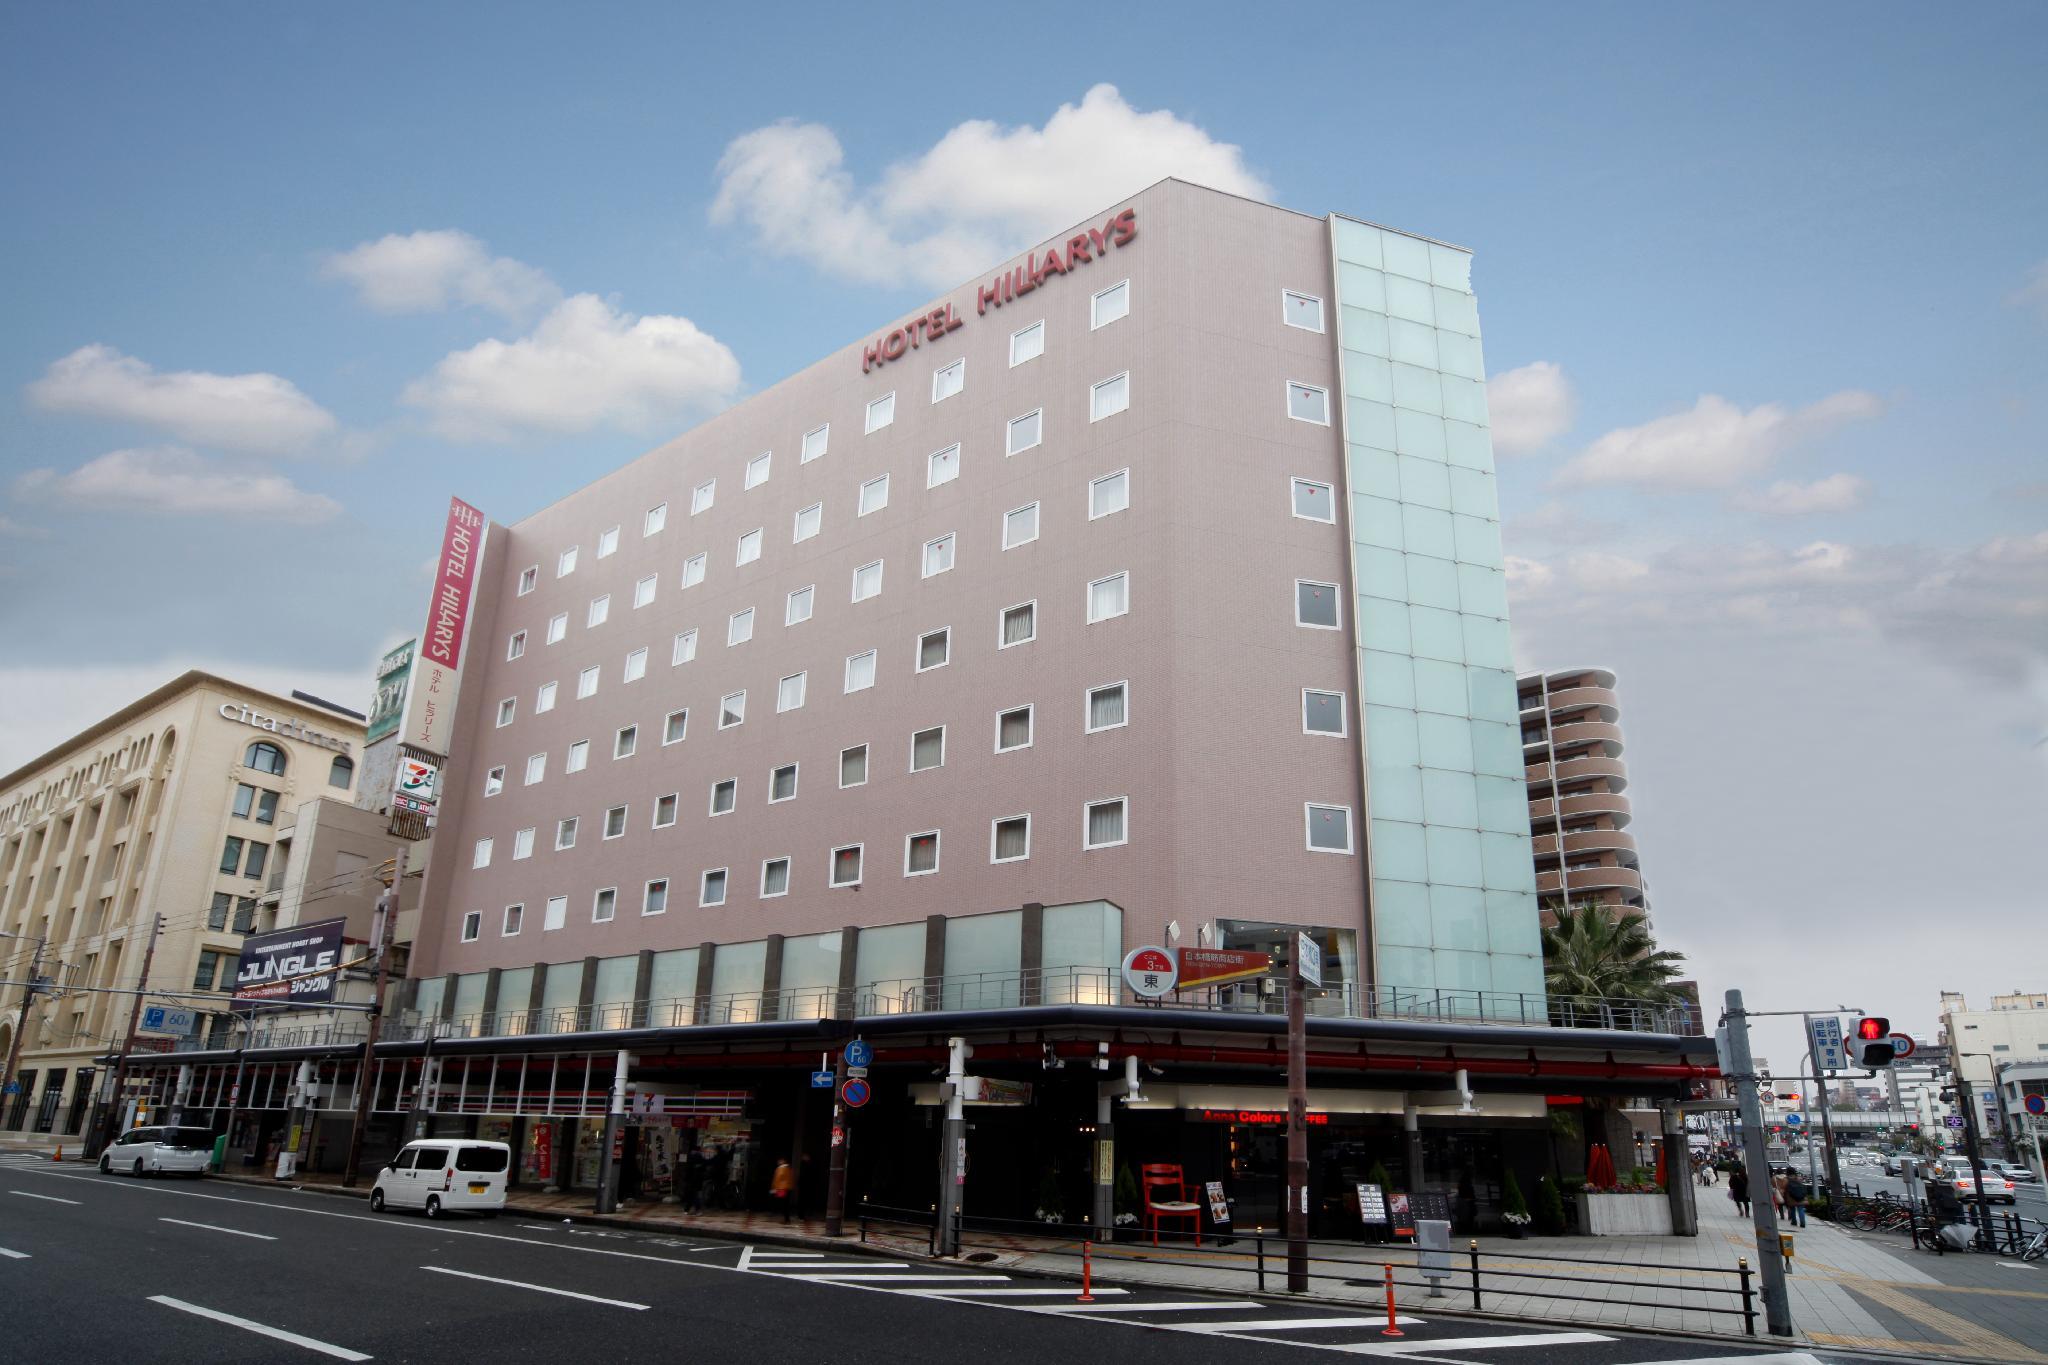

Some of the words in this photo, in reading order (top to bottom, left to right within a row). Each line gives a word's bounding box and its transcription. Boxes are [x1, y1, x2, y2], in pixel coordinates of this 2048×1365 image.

[863, 303, 964, 374] HOTEL
[977, 208, 1138, 317] HILLARYS
[446, 525, 472, 579] HOTEL
[432, 583, 462, 661] HILLARYS
[429, 669, 443, 693] ホテル
[219, 703, 352, 753] citadines
[255, 942, 292, 954] ENTERTAINMENT
[292, 938, 309, 949] HOBBY
[309, 936, 324, 946] SHOP
[238, 950, 336, 982] JUNGLE
[291, 976, 330, 994] ジャングル
[1143, 974, 1159, 989] 東
[850, 1046, 862, 1063] P
[1239, 1111, 1281, 1124] Colors
